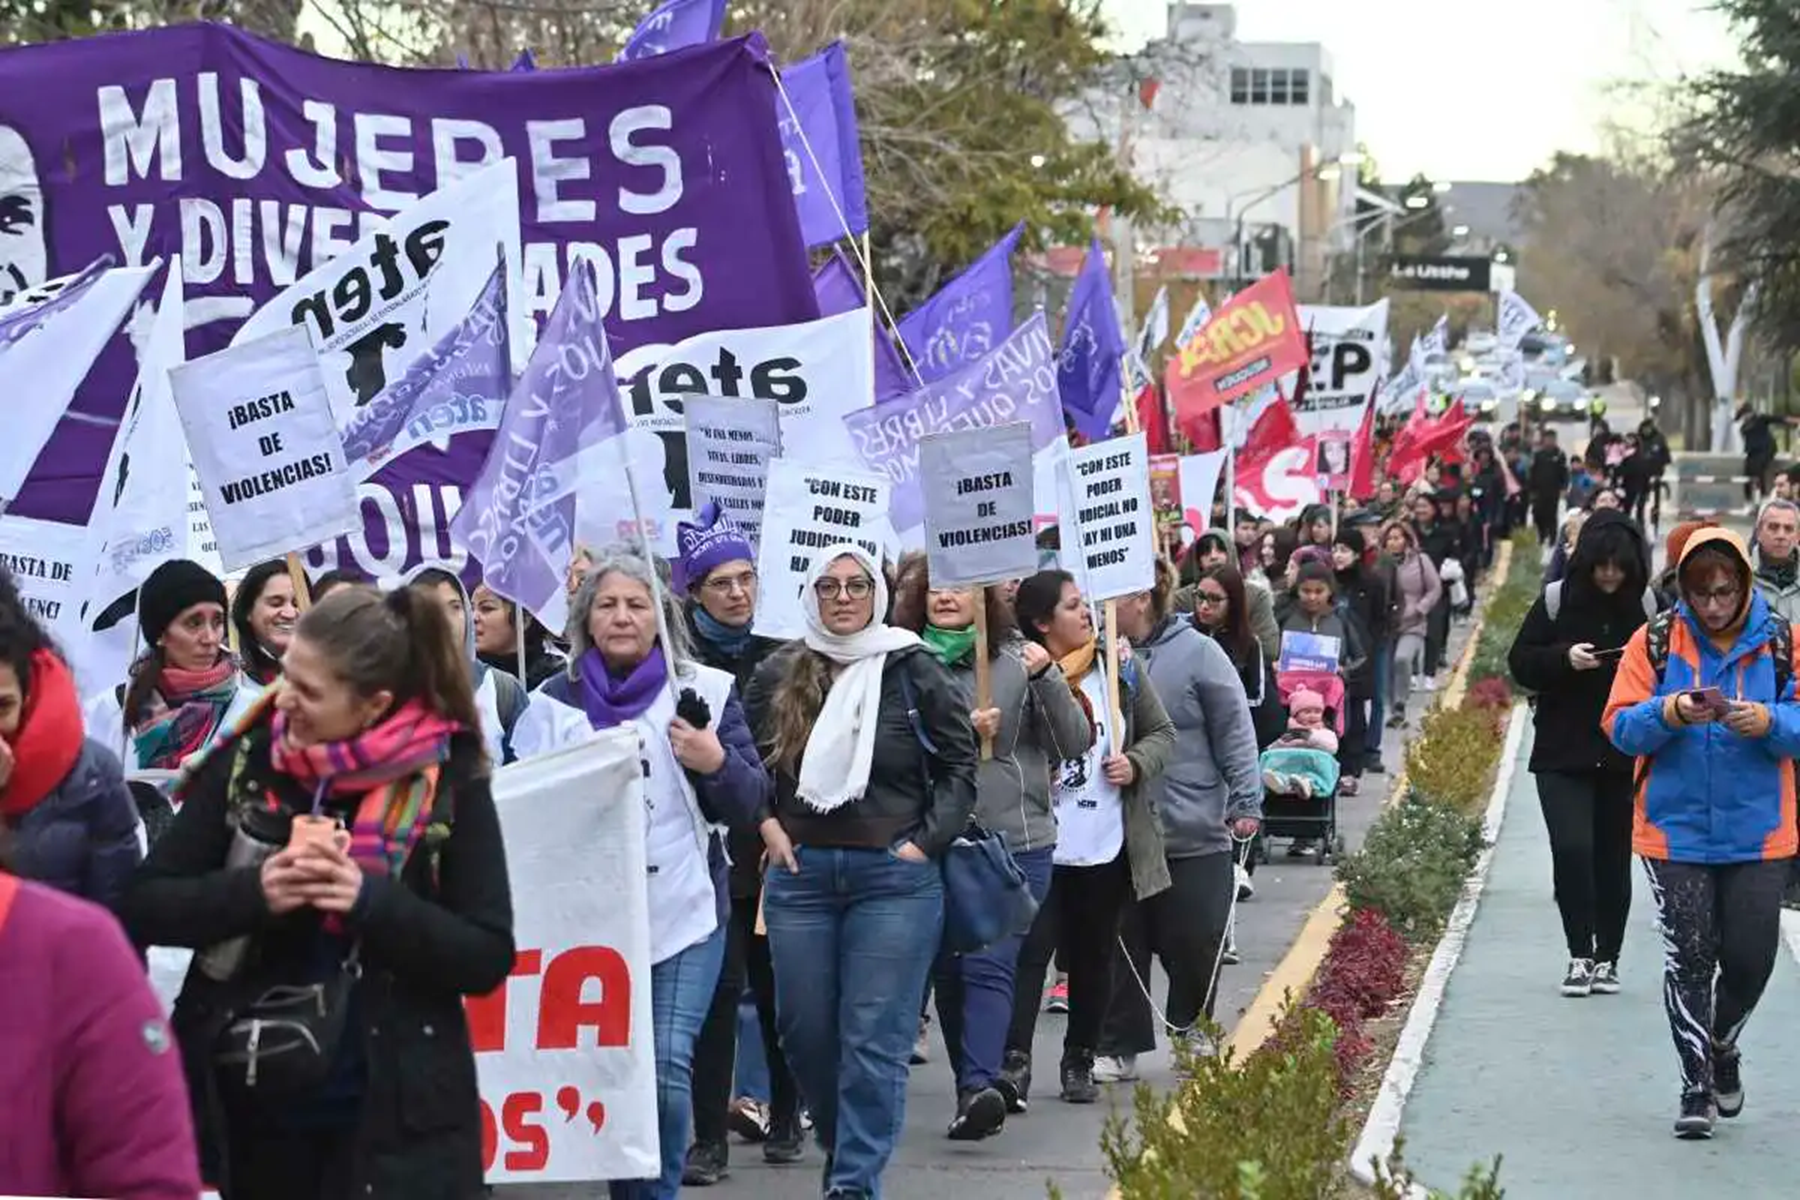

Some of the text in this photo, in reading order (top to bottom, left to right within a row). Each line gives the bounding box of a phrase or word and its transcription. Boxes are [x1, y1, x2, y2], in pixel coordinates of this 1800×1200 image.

[227, 390, 295, 430] ¡BASTA
[258, 432, 284, 457] DE
[1105, 451, 1132, 471] ESTE
[219, 452, 333, 505] VIOLENCIAS!
[957, 471, 1012, 496] ¡BASTA
[1087, 477, 1122, 499] PODER
[843, 483, 877, 505] ESTE
[813, 505, 861, 528] PODER
[977, 501, 997, 518] DE
[1122, 497, 1138, 514] NO
[938, 519, 1033, 548] VIOLENCIAS!
[1100, 527, 1113, 542] NI
[1114, 521, 1137, 540] UNA
[51, 561, 73, 581] DE
